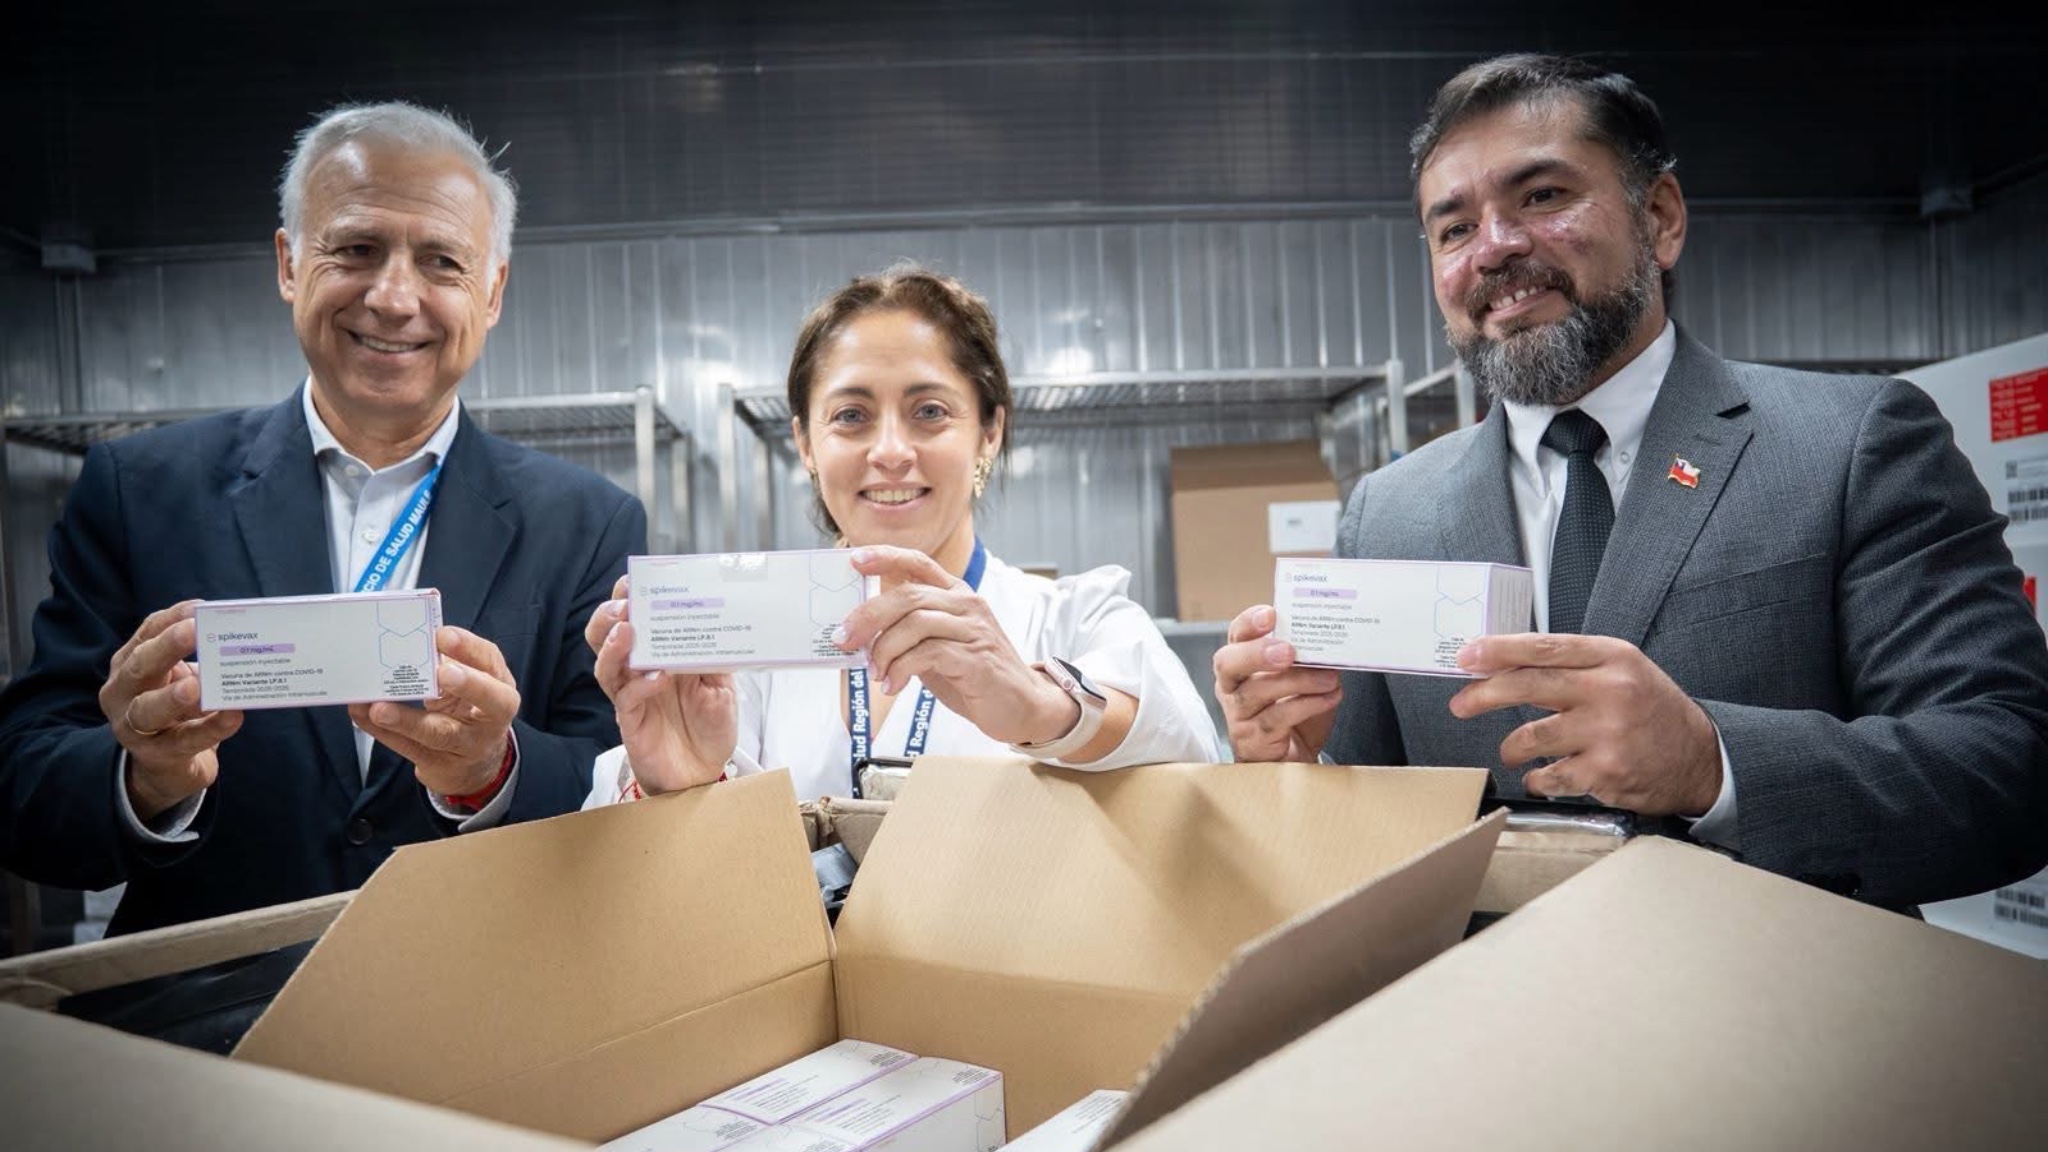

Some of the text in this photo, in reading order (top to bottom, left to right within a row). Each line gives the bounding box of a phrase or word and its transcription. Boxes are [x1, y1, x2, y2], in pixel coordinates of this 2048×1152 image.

[362, 572, 381, 592] CIO
[375, 557, 392, 573] DE
[386, 523, 414, 556] SALUD
[650, 586, 690, 595] spikevax
[1294, 574, 1327, 582] spikevax
[218, 632, 258, 642] spikevax
[850, 670, 869, 760] lud Región del
[909, 700, 932, 747] Región
